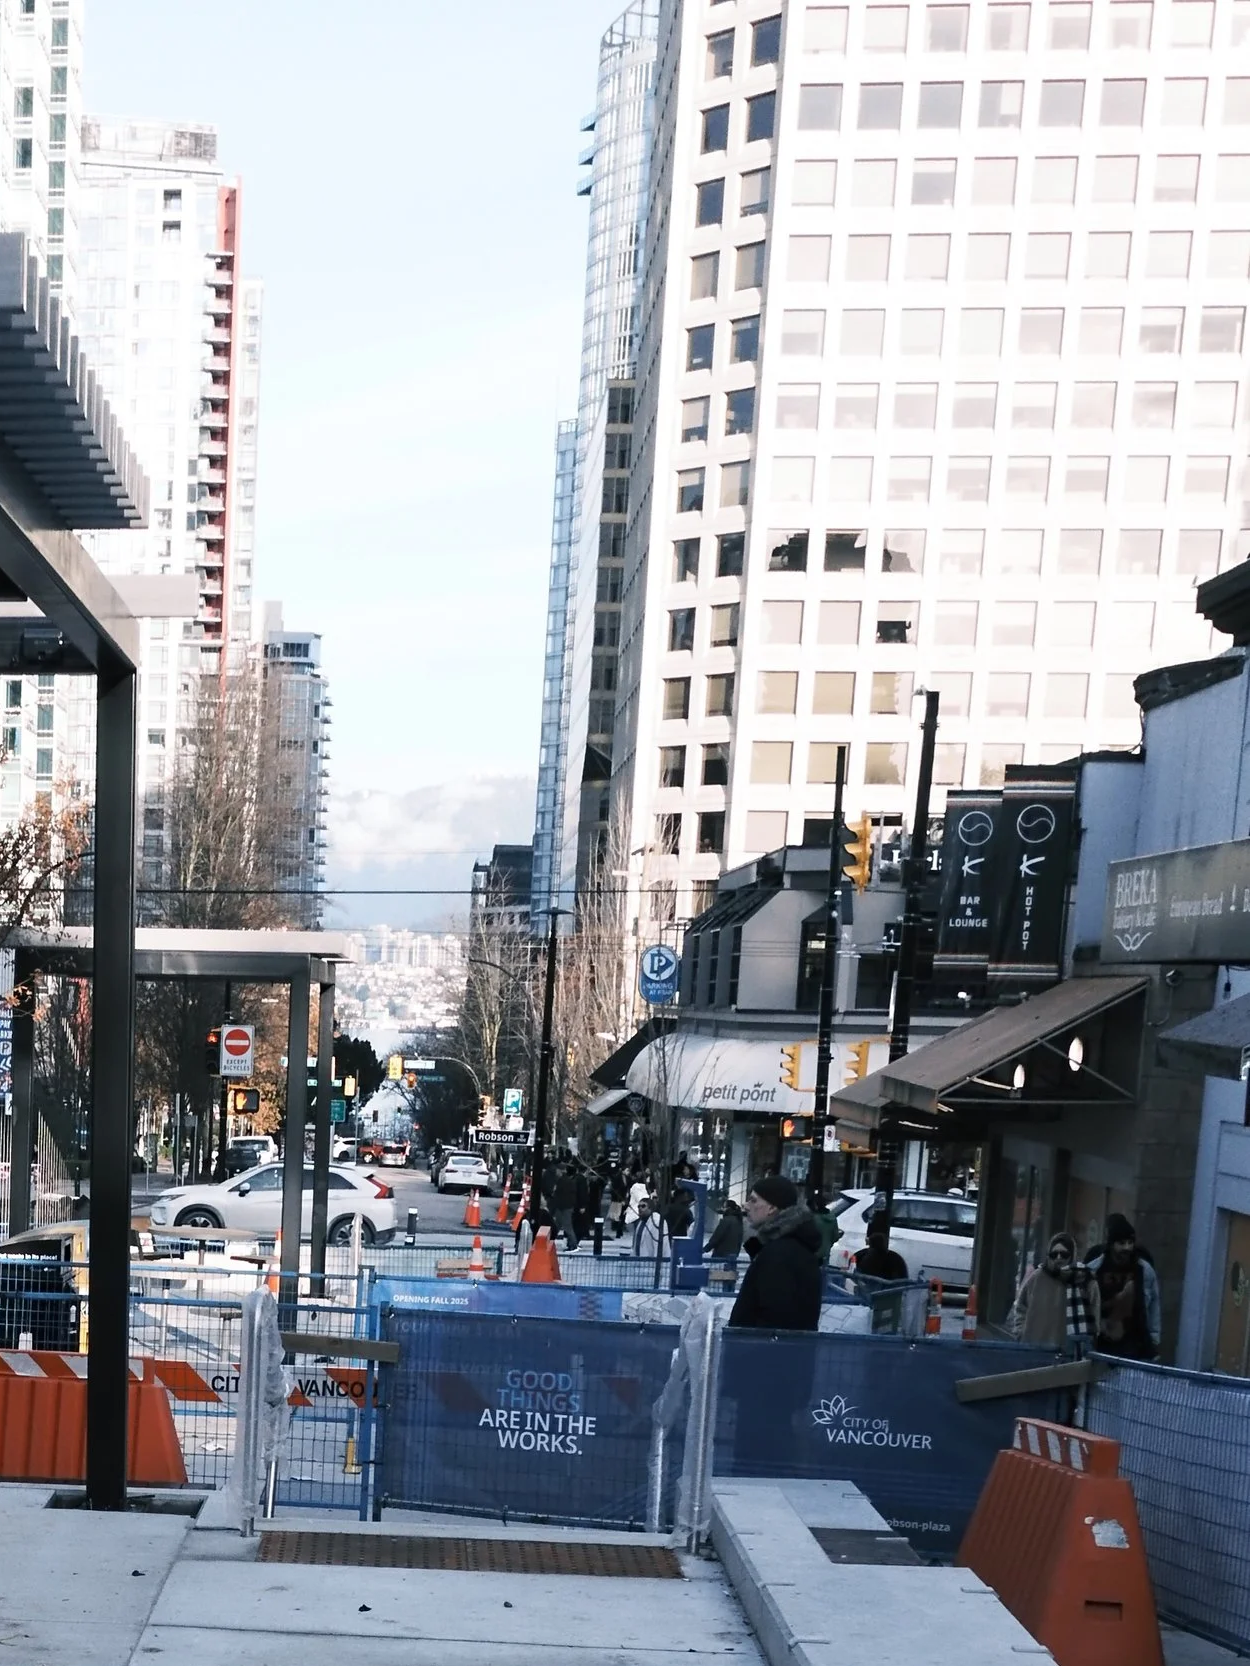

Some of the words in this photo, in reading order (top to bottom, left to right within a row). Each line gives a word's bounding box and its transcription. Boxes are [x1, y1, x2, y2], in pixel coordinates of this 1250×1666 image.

[1114, 868, 1158, 909] BREKA
[960, 896, 981, 905] BAR
[1025, 886, 1034, 916] HOT
[965, 907, 972, 916] &
[949, 918, 988, 928] LOUNGE
[1022, 921, 1031, 950] POT
[0, 1020, 12, 1029] PAY
[702, 1084, 737, 1102] petit
[478, 1131, 514, 1142] Robson
[393, 1294, 430, 1304] OPENING
[431, 1296, 449, 1305] FALL
[451, 1297, 469, 1306] 2025
[211, 1375, 240, 1393] CIT
[506, 1369, 572, 1392] GOOD
[497, 1388, 581, 1413] THINGS
[479, 1408, 521, 1430] ARE
[526, 1412, 551, 1432] IN
[554, 1414, 597, 1436] THE
[842, 1417, 868, 1429] CITY
[872, 1418, 888, 1431] OF
[498, 1429, 583, 1455] WORKS.
[826, 1428, 932, 1450] VANCOUVER
